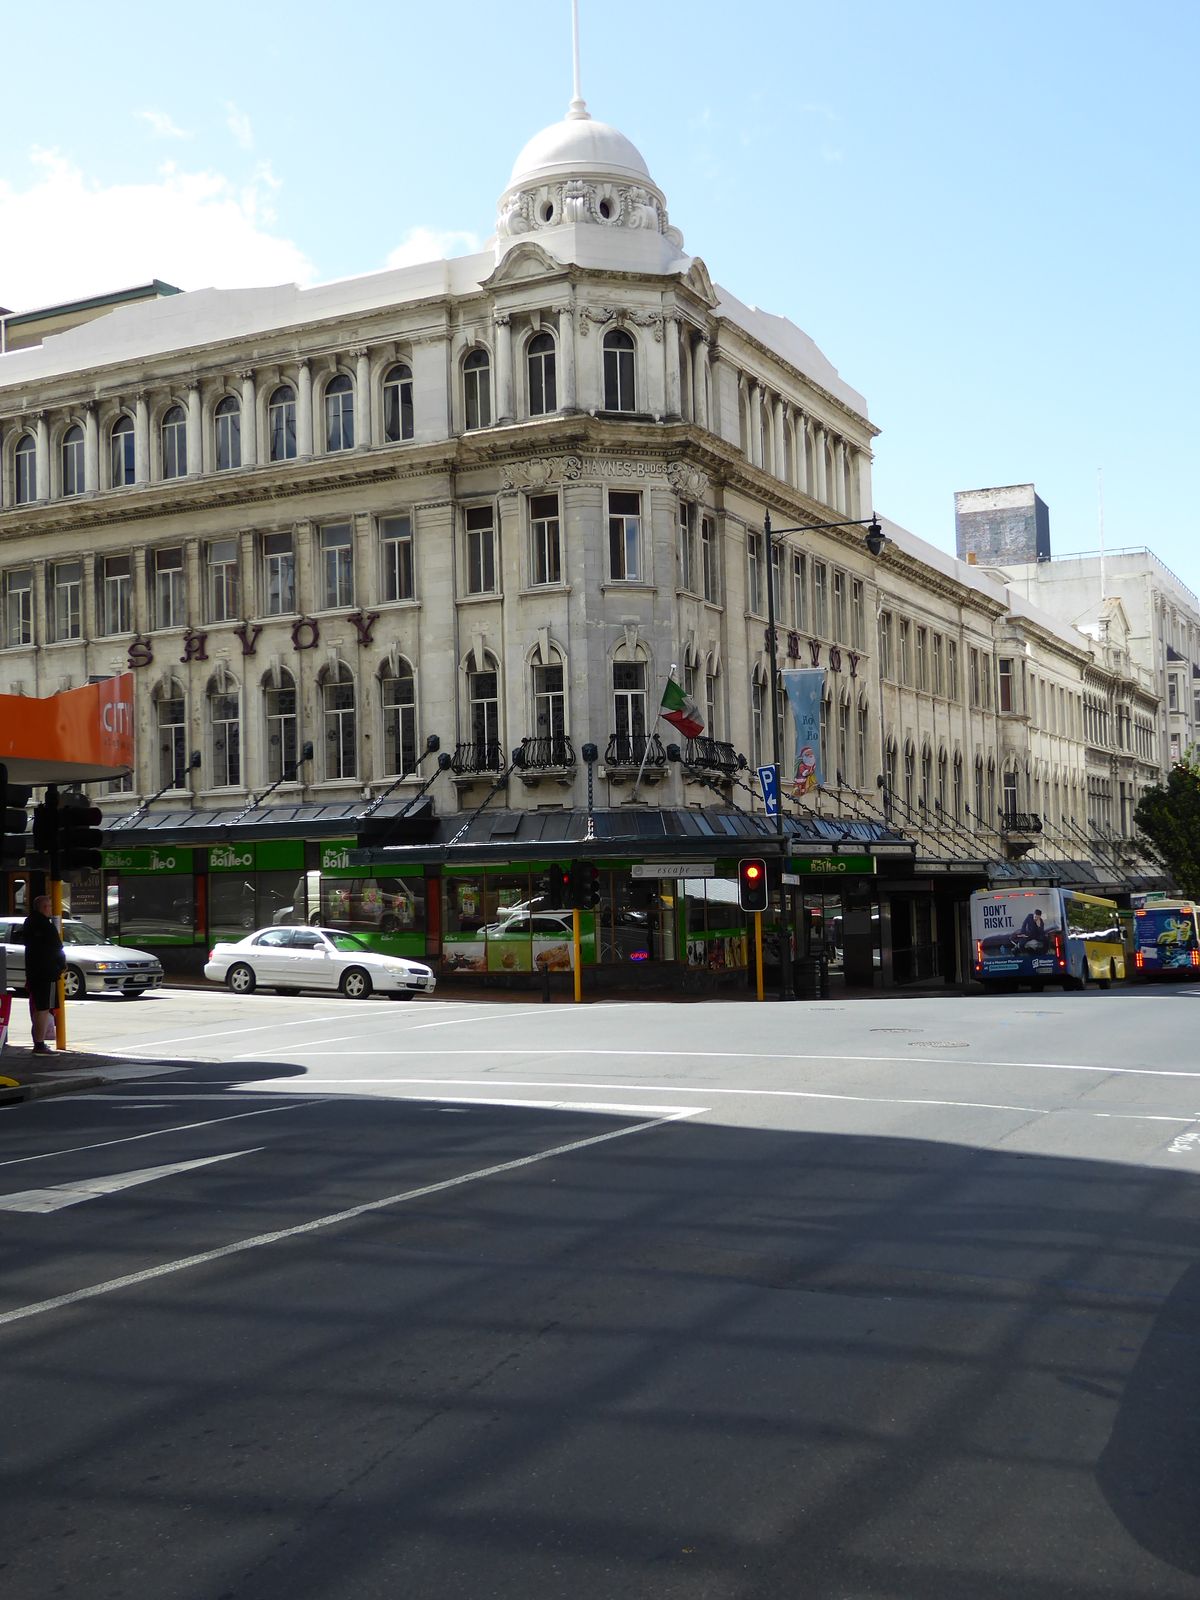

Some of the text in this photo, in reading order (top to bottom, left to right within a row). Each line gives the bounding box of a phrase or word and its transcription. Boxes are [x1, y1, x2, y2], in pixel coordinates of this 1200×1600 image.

[128, 611, 380, 669] SAVOY
[761, 770, 773, 791] P
[657, 865, 690, 876] escape
[983, 904, 1007, 917] DON'T
[984, 916, 1015, 929] RISK IT.
[630, 952, 648, 960] OPEN
